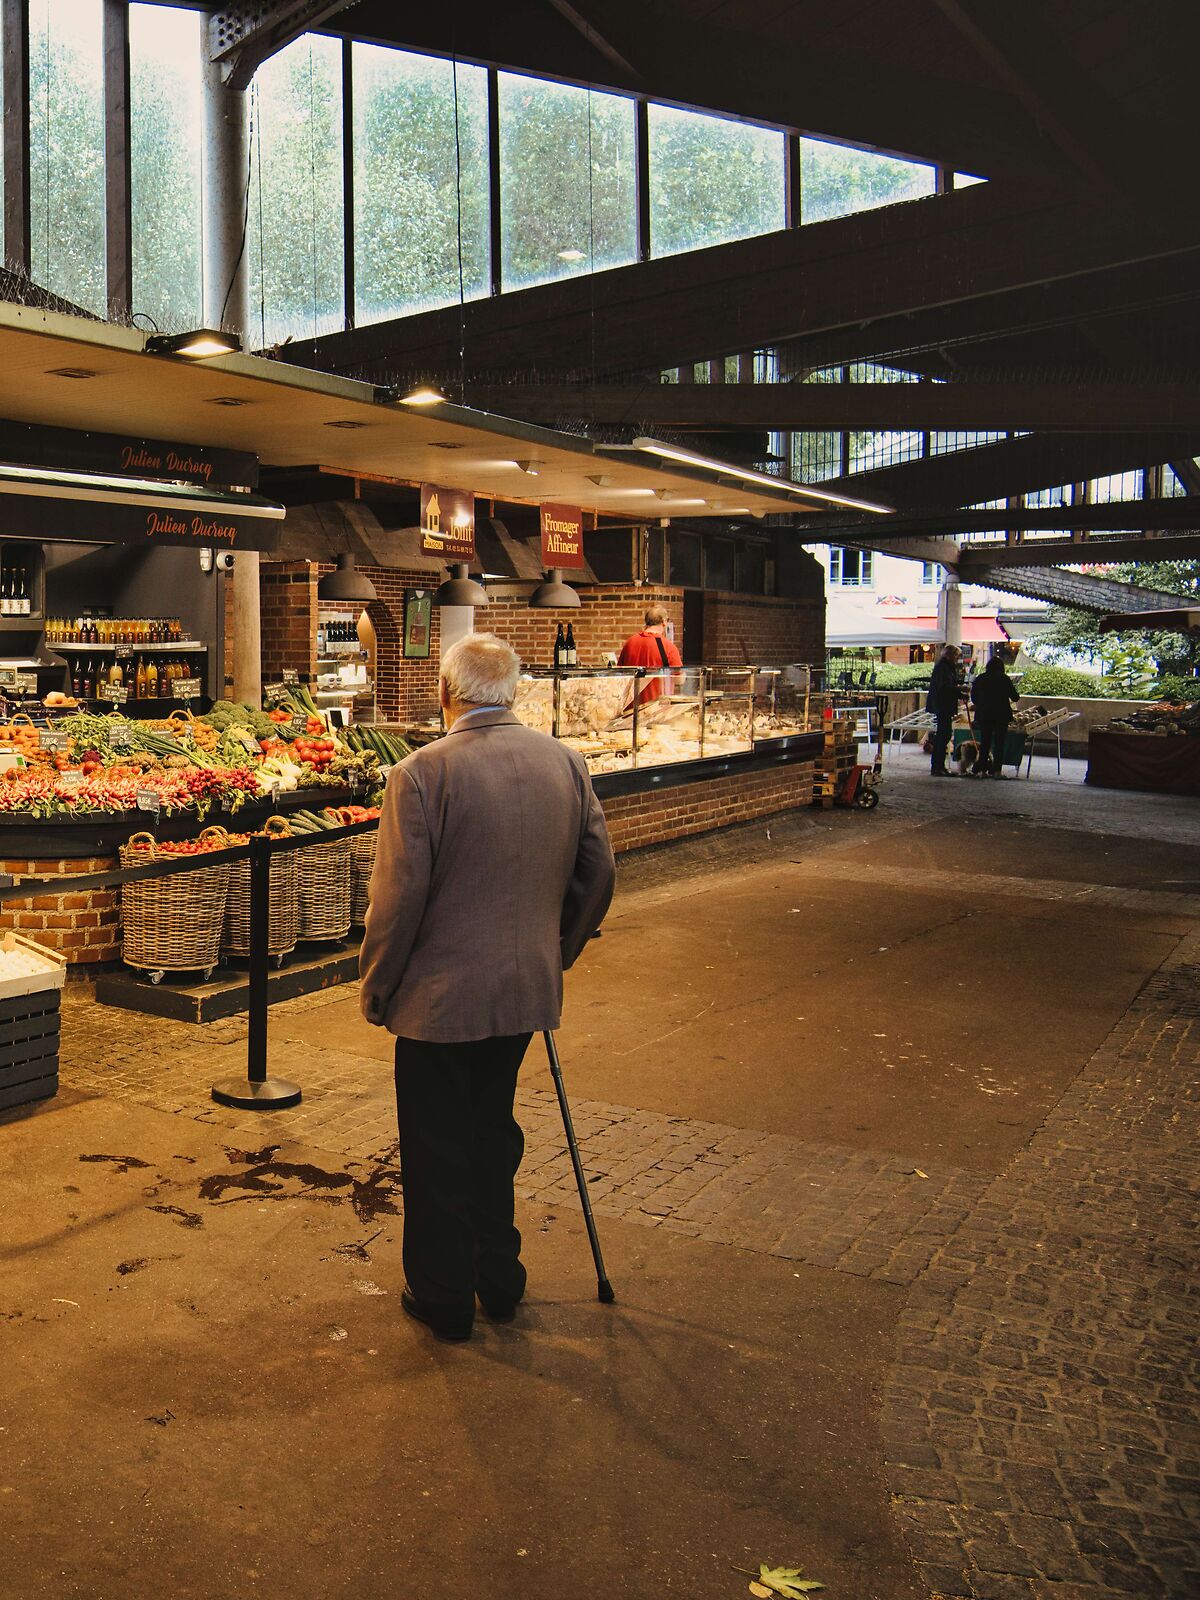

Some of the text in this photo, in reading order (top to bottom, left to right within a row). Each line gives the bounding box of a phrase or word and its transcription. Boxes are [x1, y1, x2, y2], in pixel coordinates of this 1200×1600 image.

[121, 447, 214, 481] Julien Ducrocq
[146, 512, 238, 545] Julien Ducrocq
[544, 513, 579, 539] Fromager
[547, 534, 579, 555] Affineur
